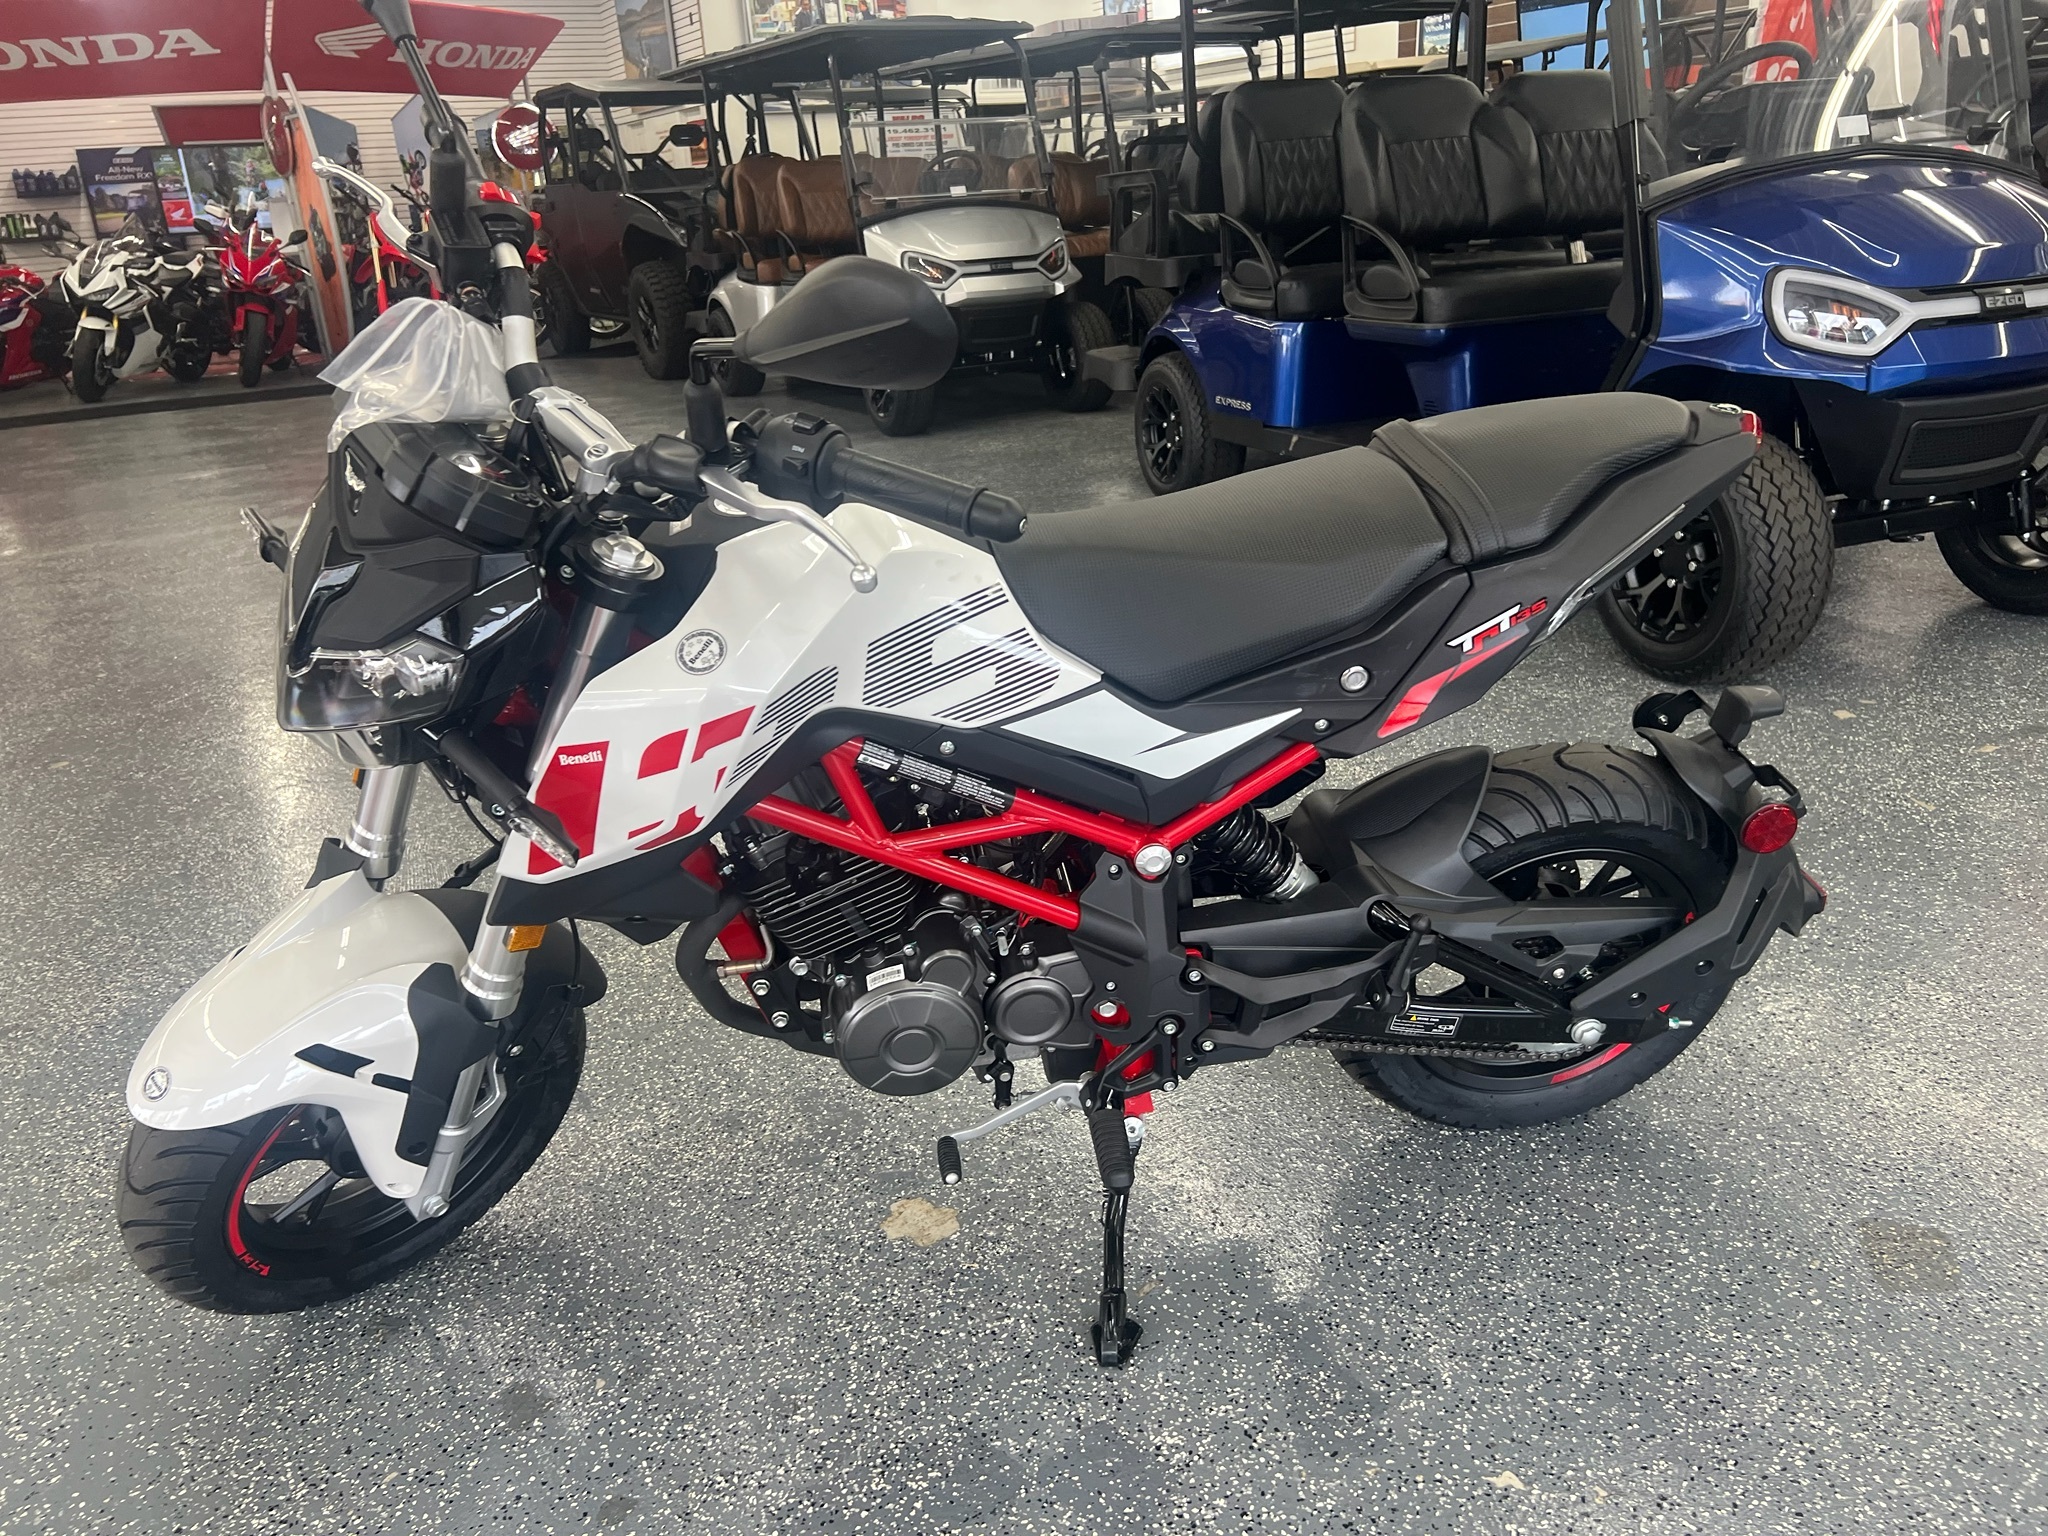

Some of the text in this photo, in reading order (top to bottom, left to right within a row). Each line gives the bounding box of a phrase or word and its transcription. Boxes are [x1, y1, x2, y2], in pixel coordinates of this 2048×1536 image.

[387, 38, 537, 70] HONDA
[1985, 293, 2025, 308] EZGO
[1215, 395, 1252, 411] EXPRESS
[688, 638, 714, 664] Benelli
[558, 750, 603, 766] Benelli
